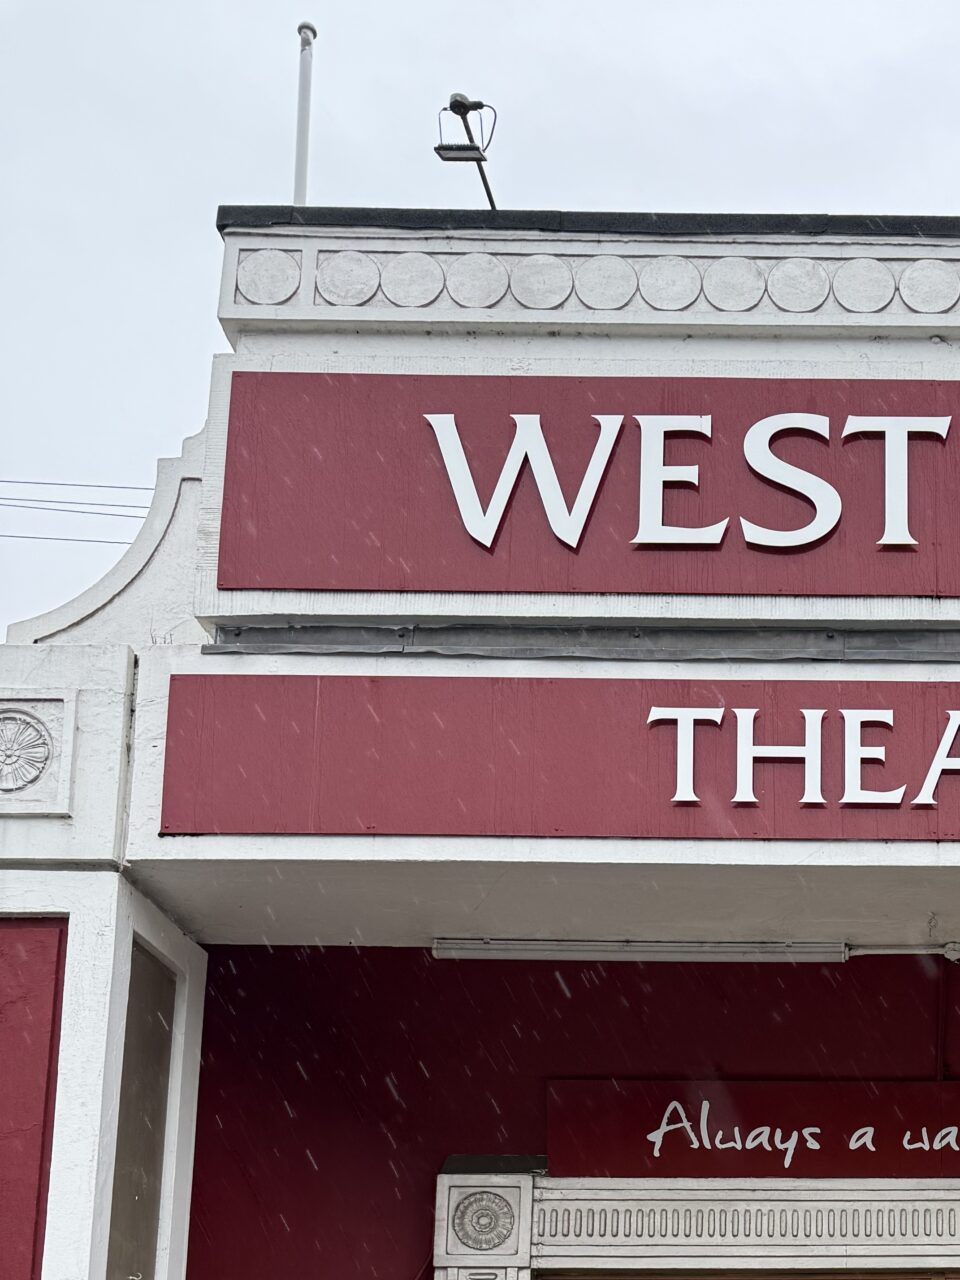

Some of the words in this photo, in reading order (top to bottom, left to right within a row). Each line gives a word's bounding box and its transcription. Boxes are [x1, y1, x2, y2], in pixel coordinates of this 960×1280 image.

[423, 412, 952, 548] WEST
[646, 1100, 821, 1168] Always
[849, 1125, 876, 1151] a
